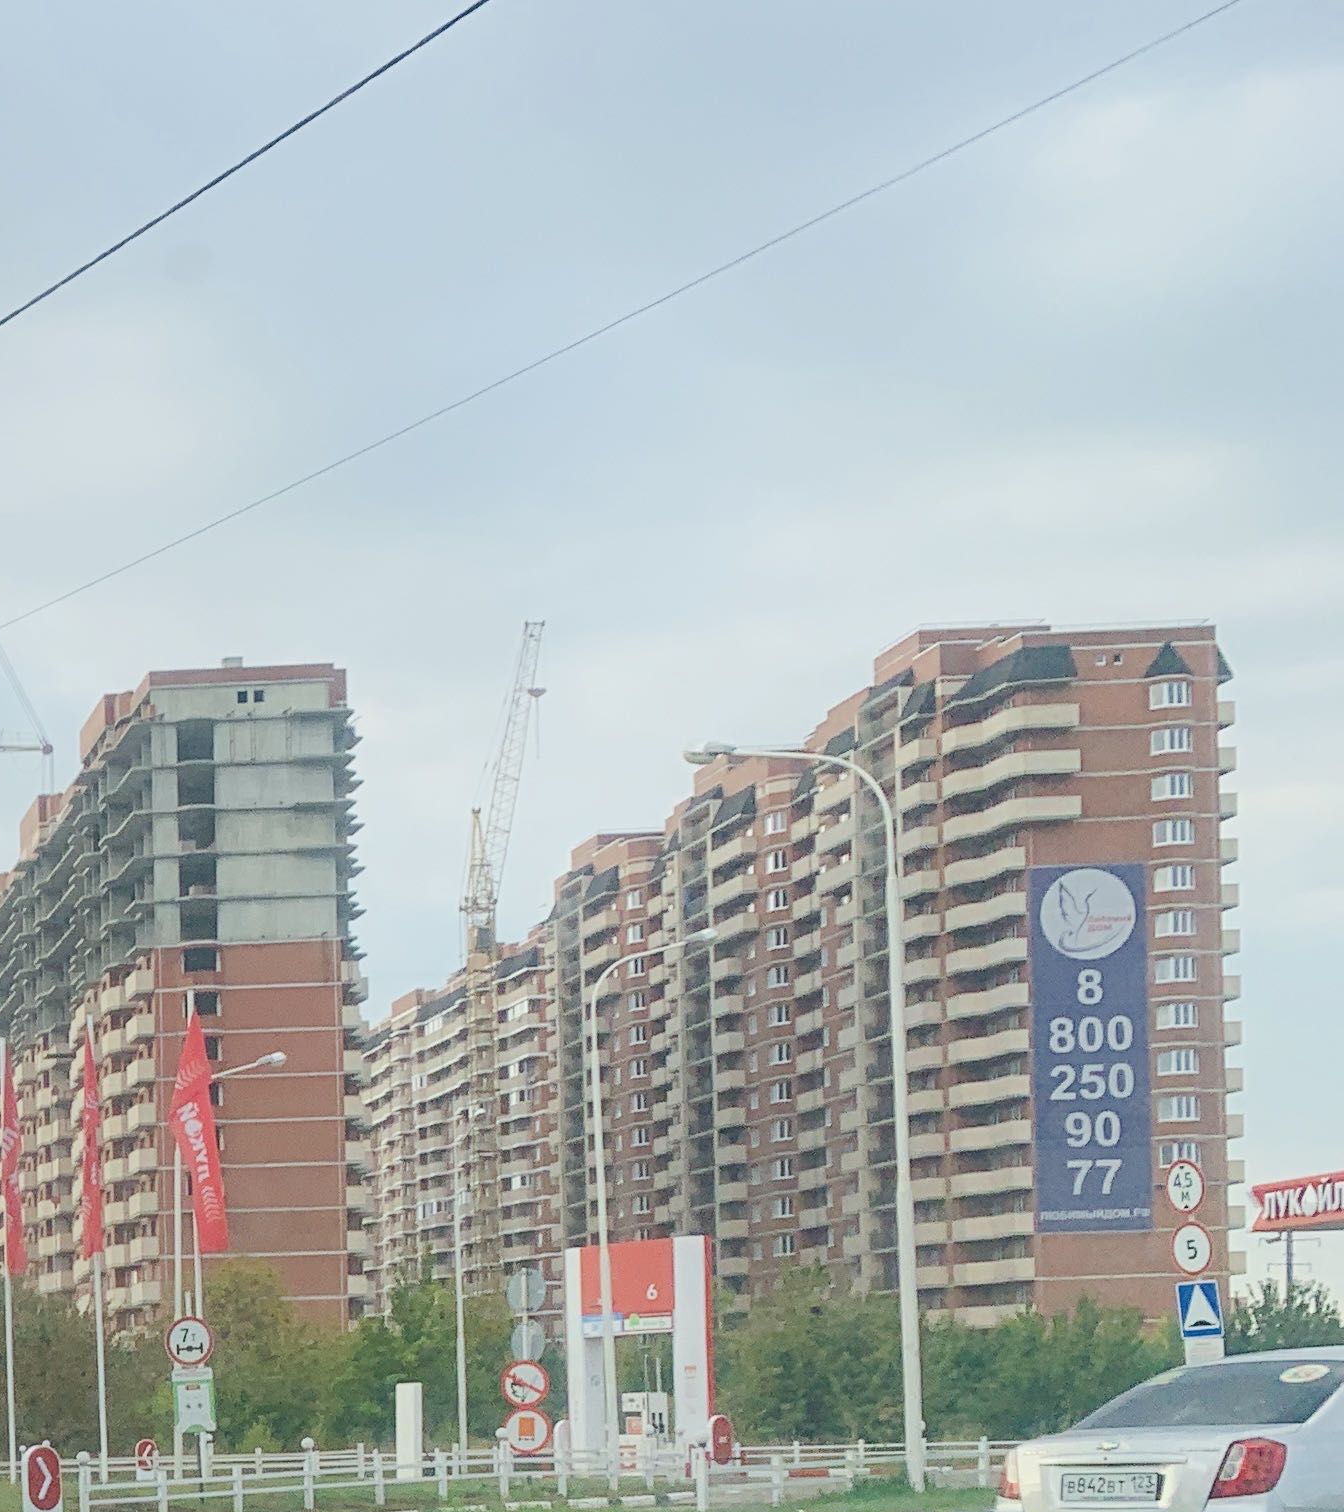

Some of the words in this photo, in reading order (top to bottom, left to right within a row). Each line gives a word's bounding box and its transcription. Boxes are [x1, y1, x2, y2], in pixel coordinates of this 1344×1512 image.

[1076, 968, 1104, 1006] 8
[1048, 1015, 1134, 1054] 800
[1049, 1063, 1135, 1101] 250
[1064, 1110, 1122, 1148] 90
[1066, 1158, 1122, 1196] 77
[1186, 1239, 1198, 1260] 5
[646, 1283, 659, 1301] 6
[180, 1328, 190, 1343] 7
